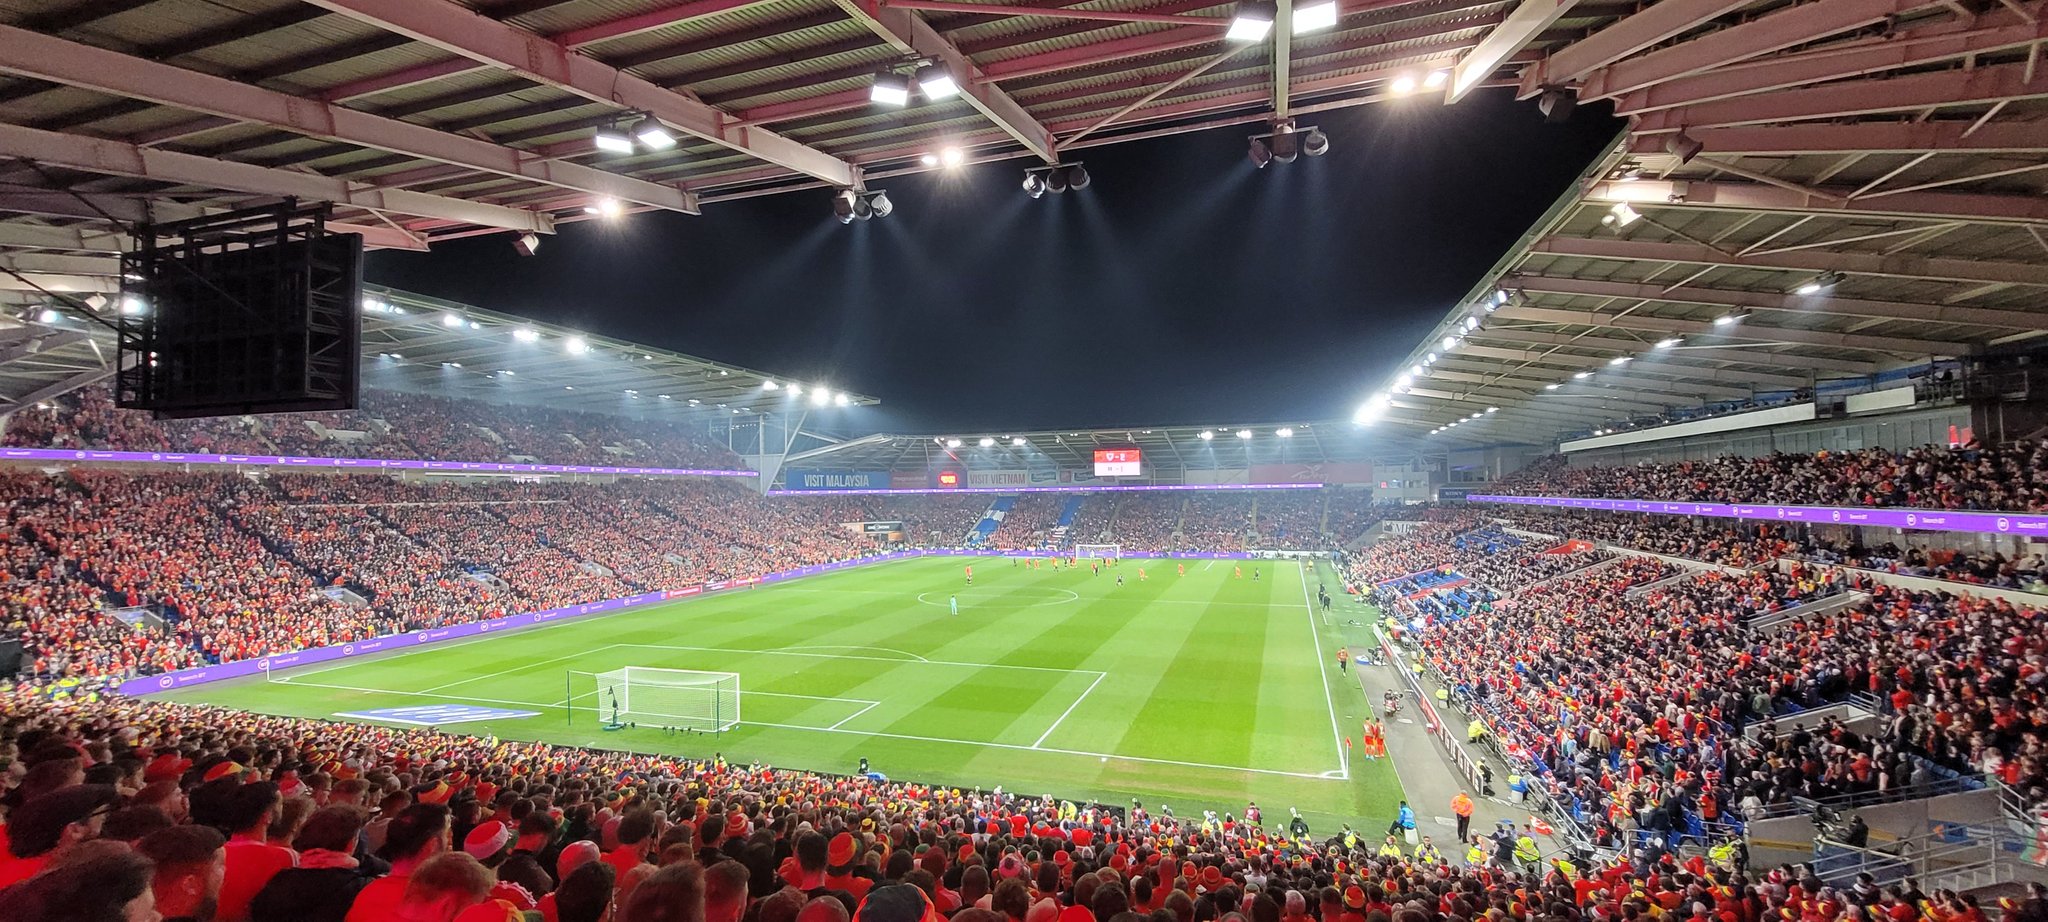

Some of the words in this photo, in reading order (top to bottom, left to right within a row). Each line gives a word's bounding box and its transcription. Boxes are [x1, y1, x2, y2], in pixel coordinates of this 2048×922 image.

[804, 474, 824, 487] VISIT
[826, 474, 869, 487] MALAYSIA
[970, 473, 988, 485] VISIT
[990, 473, 1026, 485] VIETNAM
